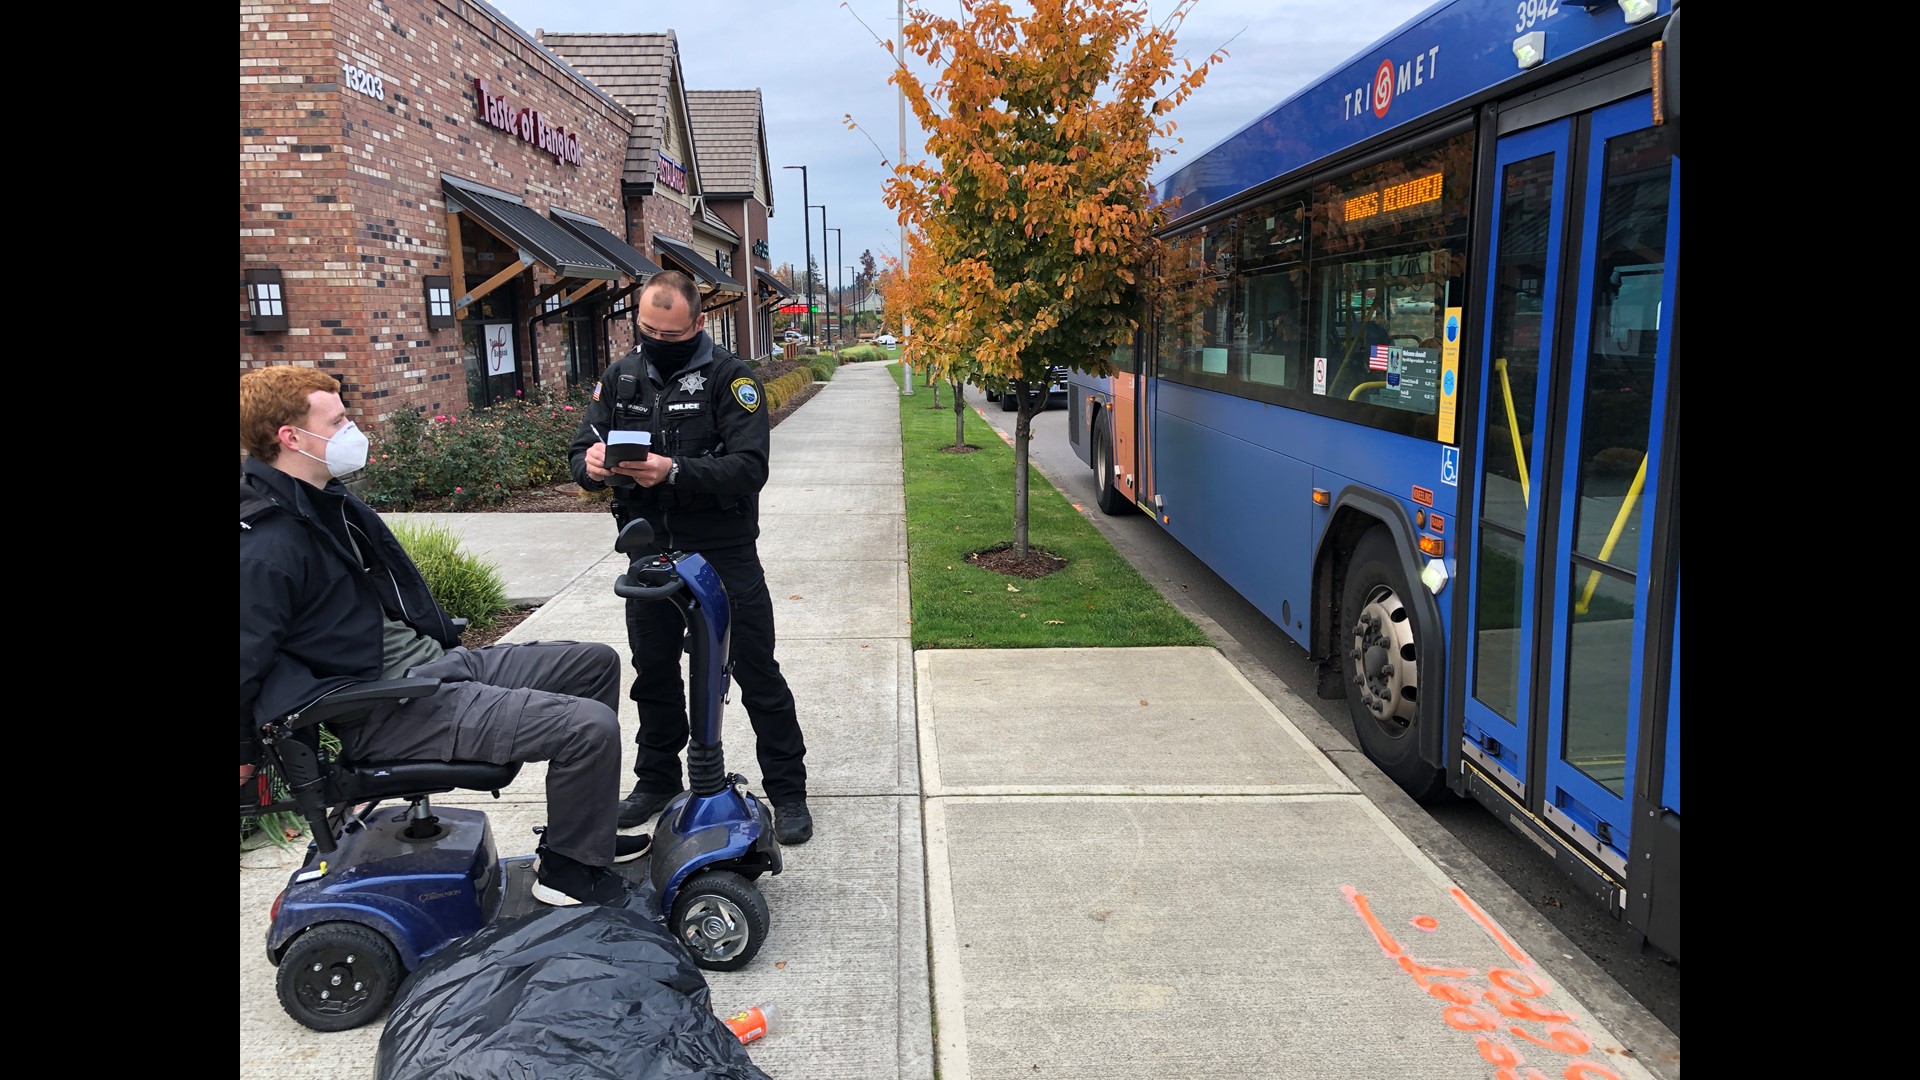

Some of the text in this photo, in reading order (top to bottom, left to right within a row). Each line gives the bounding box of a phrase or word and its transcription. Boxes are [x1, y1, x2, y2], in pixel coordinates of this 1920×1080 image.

[1515, 0, 1559, 33] 3942
[342, 63, 384, 101] 13203
[1344, 45, 1440, 121] TRI MET
[477, 79, 582, 168] Taste of Bangkok
[1345, 172, 1443, 222] MASKS REQUIRED
[668, 403, 700, 411] POLICE
